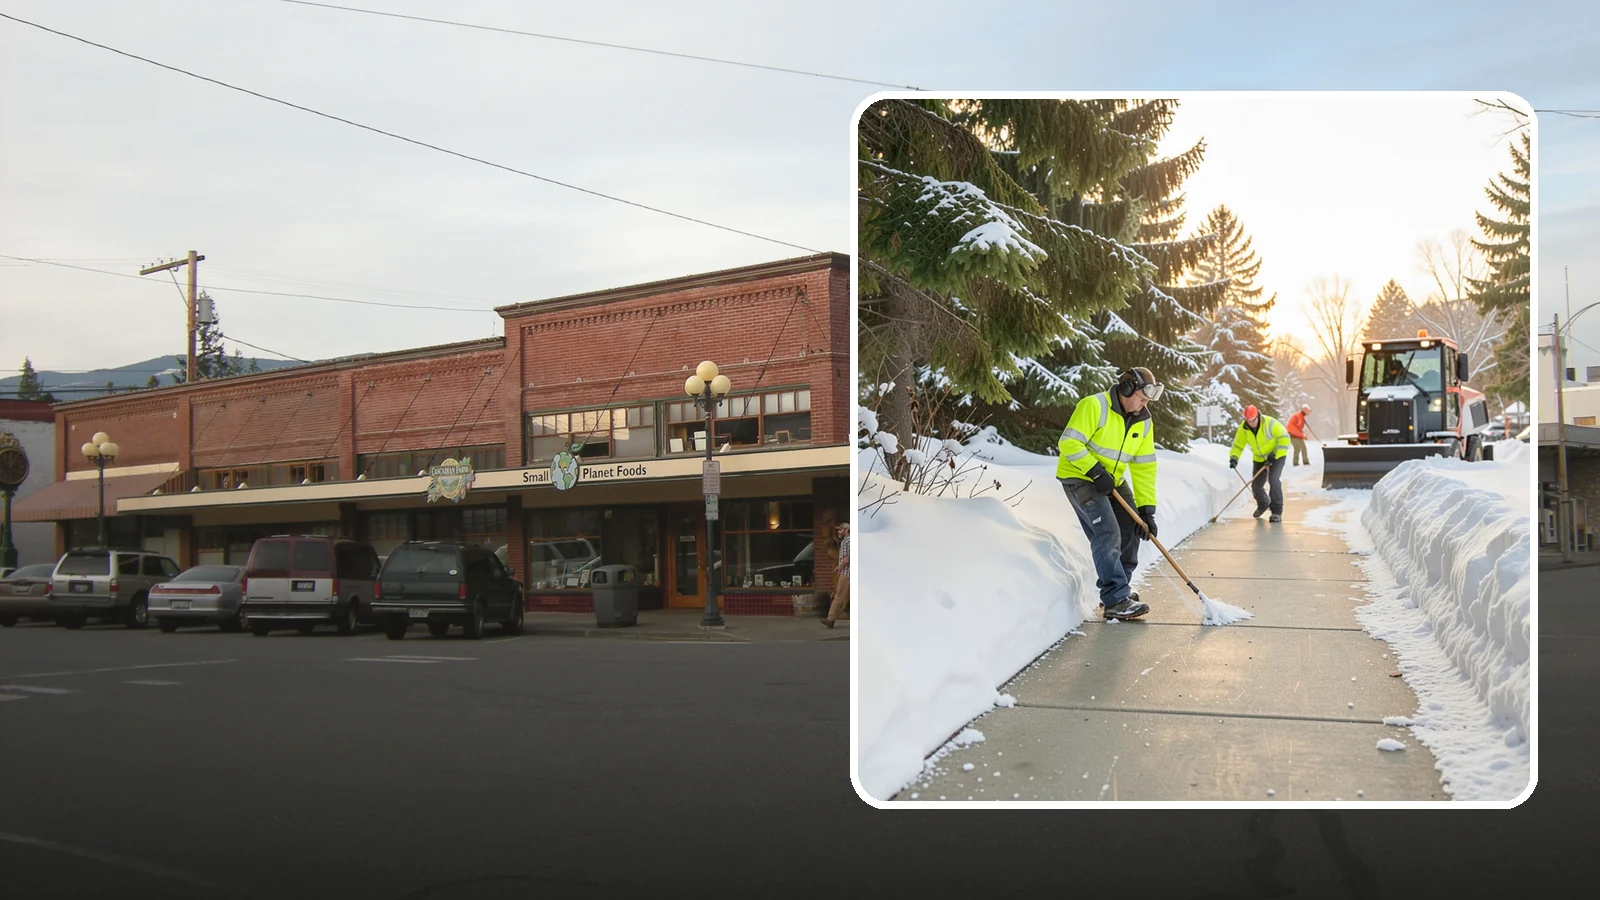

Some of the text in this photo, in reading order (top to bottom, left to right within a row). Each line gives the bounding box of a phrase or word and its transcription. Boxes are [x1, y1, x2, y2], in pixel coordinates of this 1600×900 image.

[431, 465, 469, 476] CASCADIAN FARM
[523, 464, 647, 483] Small Planet Foods
